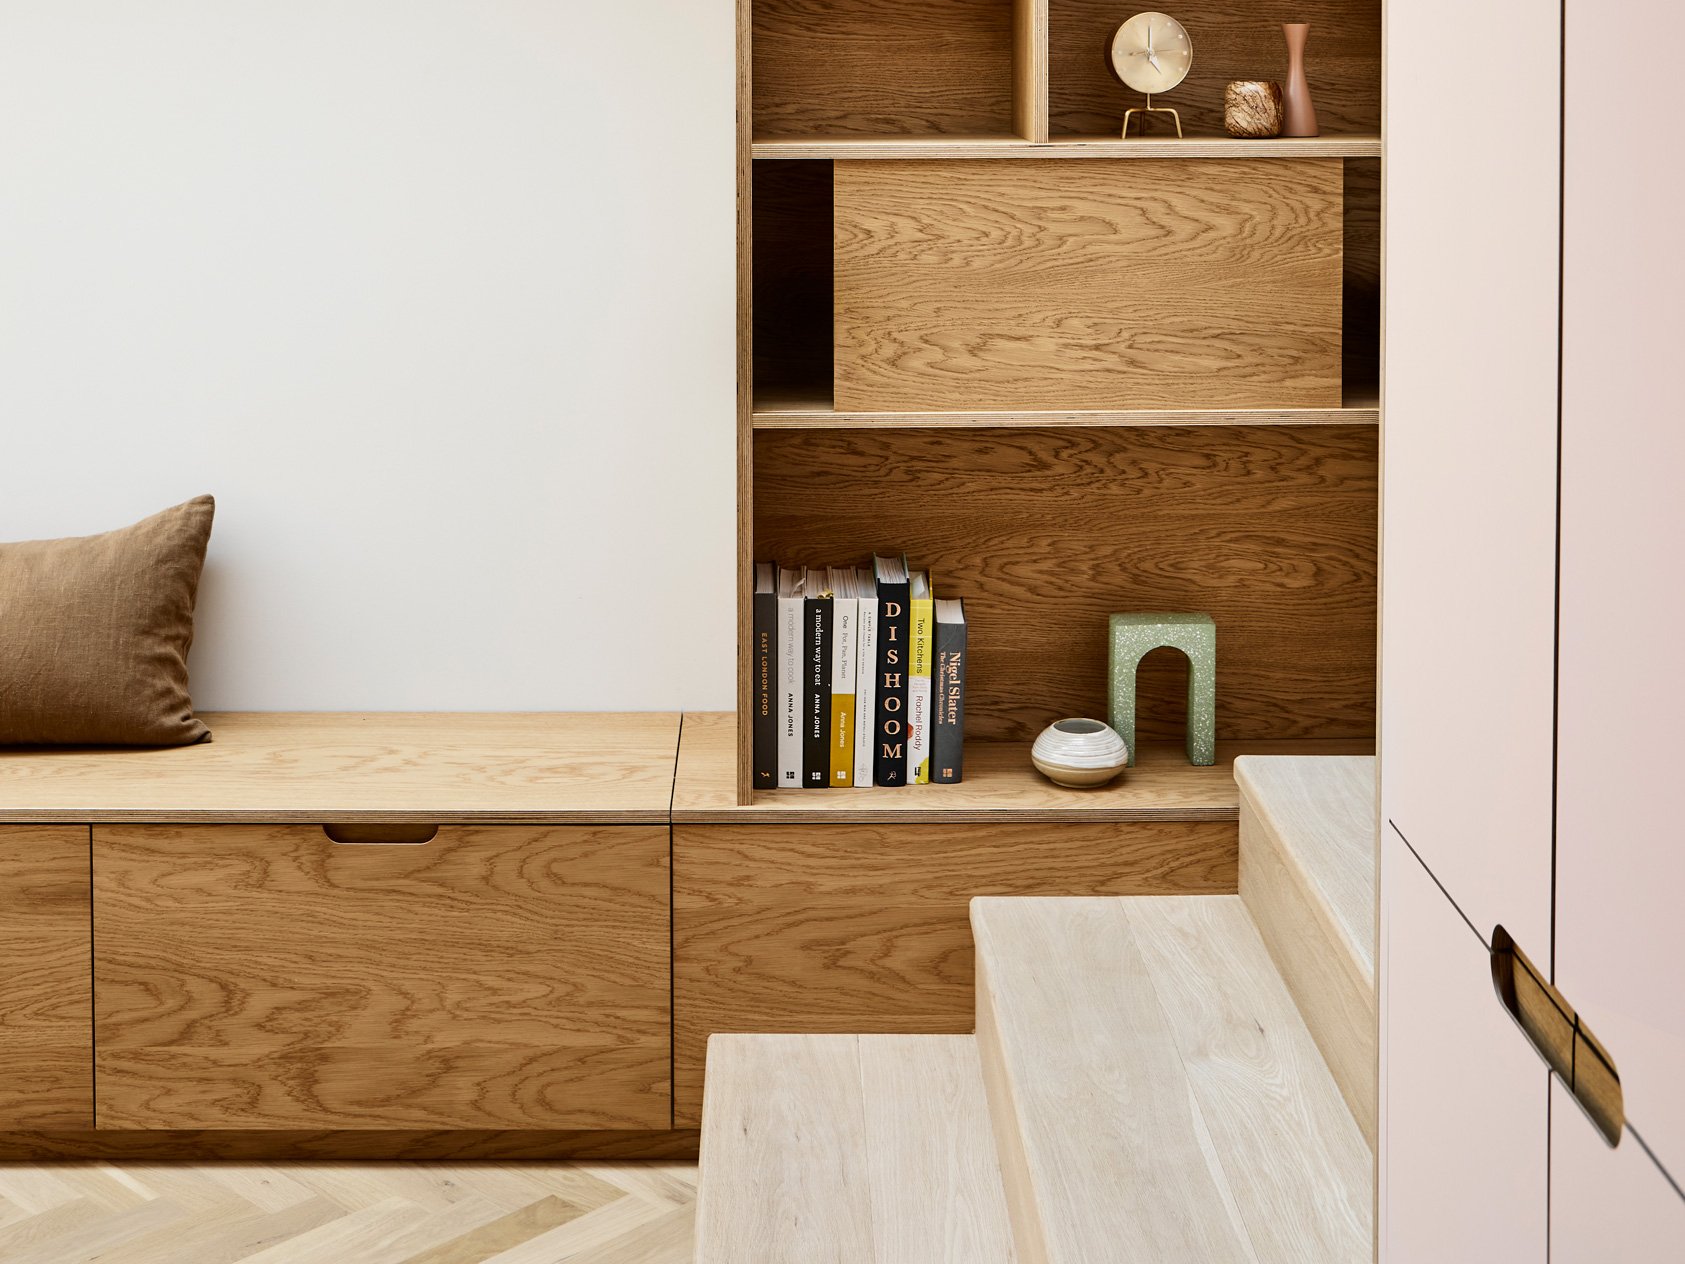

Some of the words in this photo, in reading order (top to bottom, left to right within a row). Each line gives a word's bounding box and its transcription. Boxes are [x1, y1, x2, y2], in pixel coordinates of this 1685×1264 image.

[788, 613, 796, 642] modern
[815, 614, 823, 646] modern
[917, 618, 925, 635] Two
[785, 643, 795, 657] way
[812, 647, 822, 663] way
[916, 638, 925, 674] Kitchens
[787, 658, 795, 666] to
[814, 664, 822, 673] to
[946, 651, 961, 685] Nigel
[787, 667, 796, 684] cook
[814, 674, 822, 686] eat
[881, 602, 903, 759] DISHOOM
[915, 695, 924, 724] Rachel
[947, 686, 961, 725] Slater
[813, 715, 821, 738] JONES
[839, 711, 847, 728] Anna
[913, 724, 923, 751] Roddy
